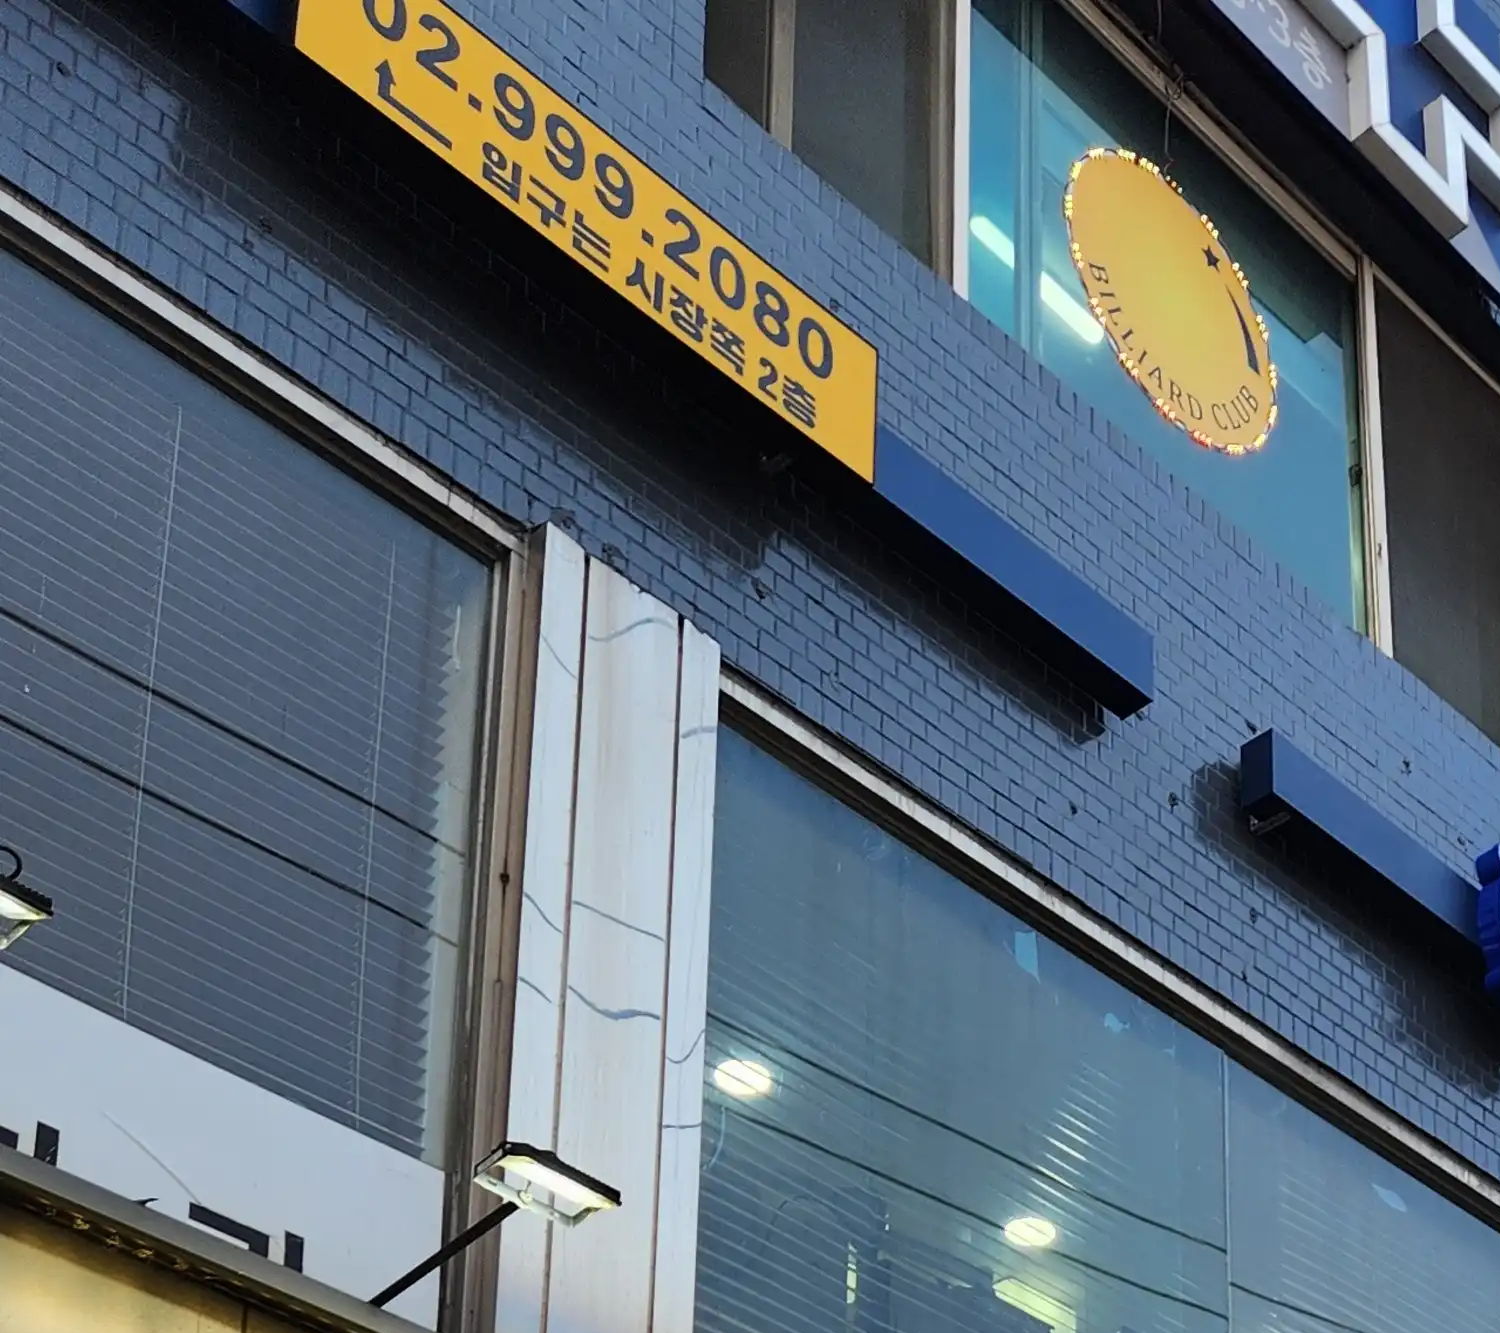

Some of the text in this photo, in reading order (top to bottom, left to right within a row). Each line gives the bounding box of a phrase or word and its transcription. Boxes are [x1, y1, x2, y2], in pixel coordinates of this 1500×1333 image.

[361, 0, 834, 381] 02.999.2080
[480, 140, 817, 431] 입구는 시장쪽 2층
[1088, 261, 1260, 432] BILLIARD CLUB
